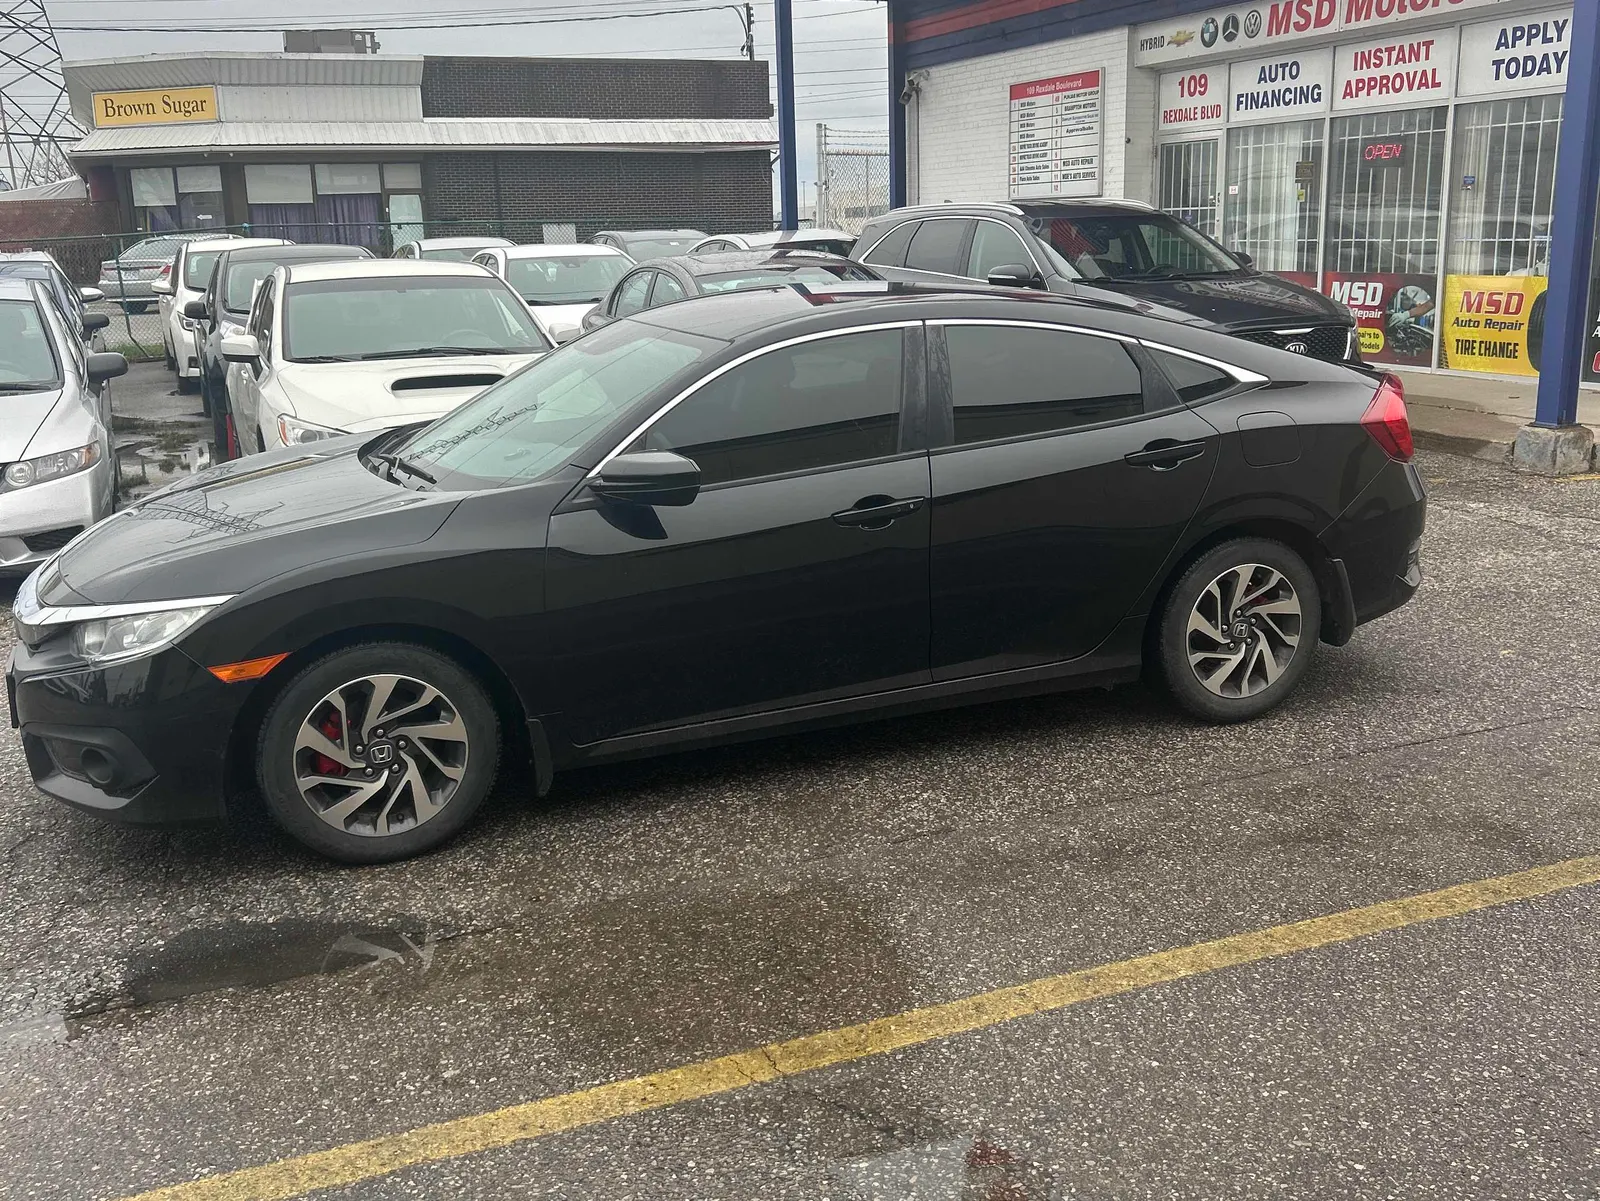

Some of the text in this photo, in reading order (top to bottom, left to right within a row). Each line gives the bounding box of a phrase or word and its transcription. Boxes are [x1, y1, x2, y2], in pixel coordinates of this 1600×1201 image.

[1266, 0, 1336, 37] MSD
[1140, 36, 1165, 51] HYBRID
[1495, 19, 1568, 51] APPLY
[1353, 40, 1435, 71] INSTANT
[1492, 51, 1568, 81] TODAY
[1257, 61, 1300, 85] AUTO
[1342, 68, 1441, 99] APPROVAL
[1026, 79, 1082, 94] 109 Rexdale Boulevard
[1178, 74, 1208, 98] 109
[1236, 84, 1322, 111] FINANCING
[102, 95, 206, 117] Brown Sugar
[1163, 104, 1221, 124] REXDALE BLVD
[1364, 144, 1402, 161] OPEN
[1330, 281, 1384, 306] MSD
[1460, 291, 1525, 316] MSD
[1452, 317, 1524, 332] Auto Repair
[1455, 338, 1519, 360] TIRE CHANGE
